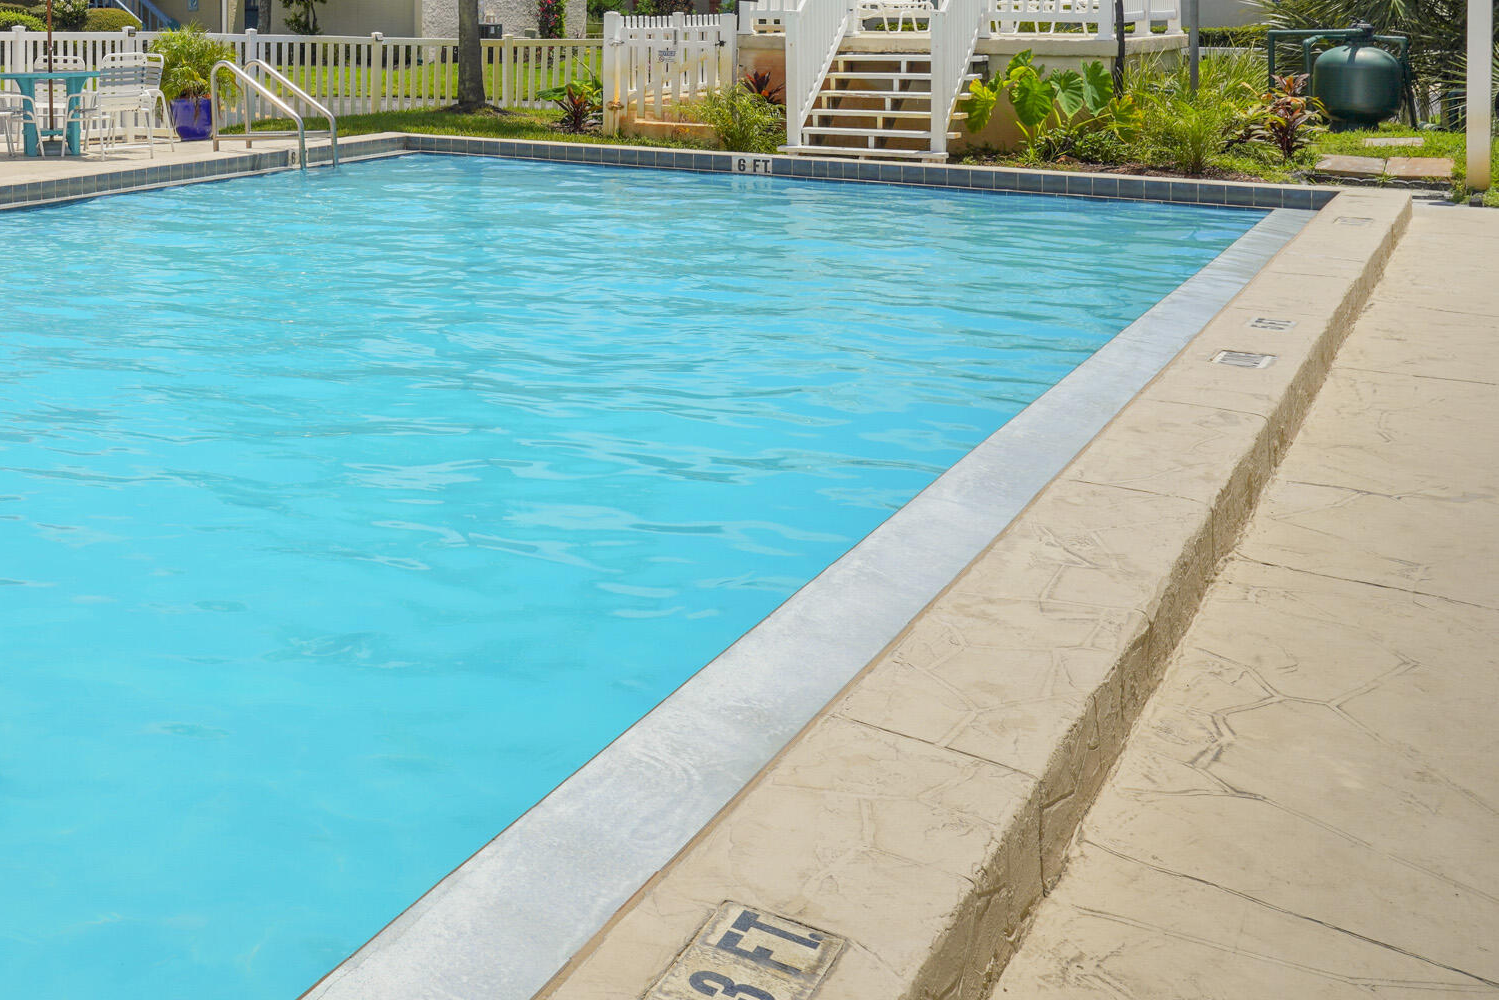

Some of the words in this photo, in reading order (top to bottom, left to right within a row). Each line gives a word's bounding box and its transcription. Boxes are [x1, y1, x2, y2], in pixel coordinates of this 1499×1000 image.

[737, 158, 746, 172] 6
[752, 159, 771, 174] FT.
[688, 970, 776, 1000] 3
